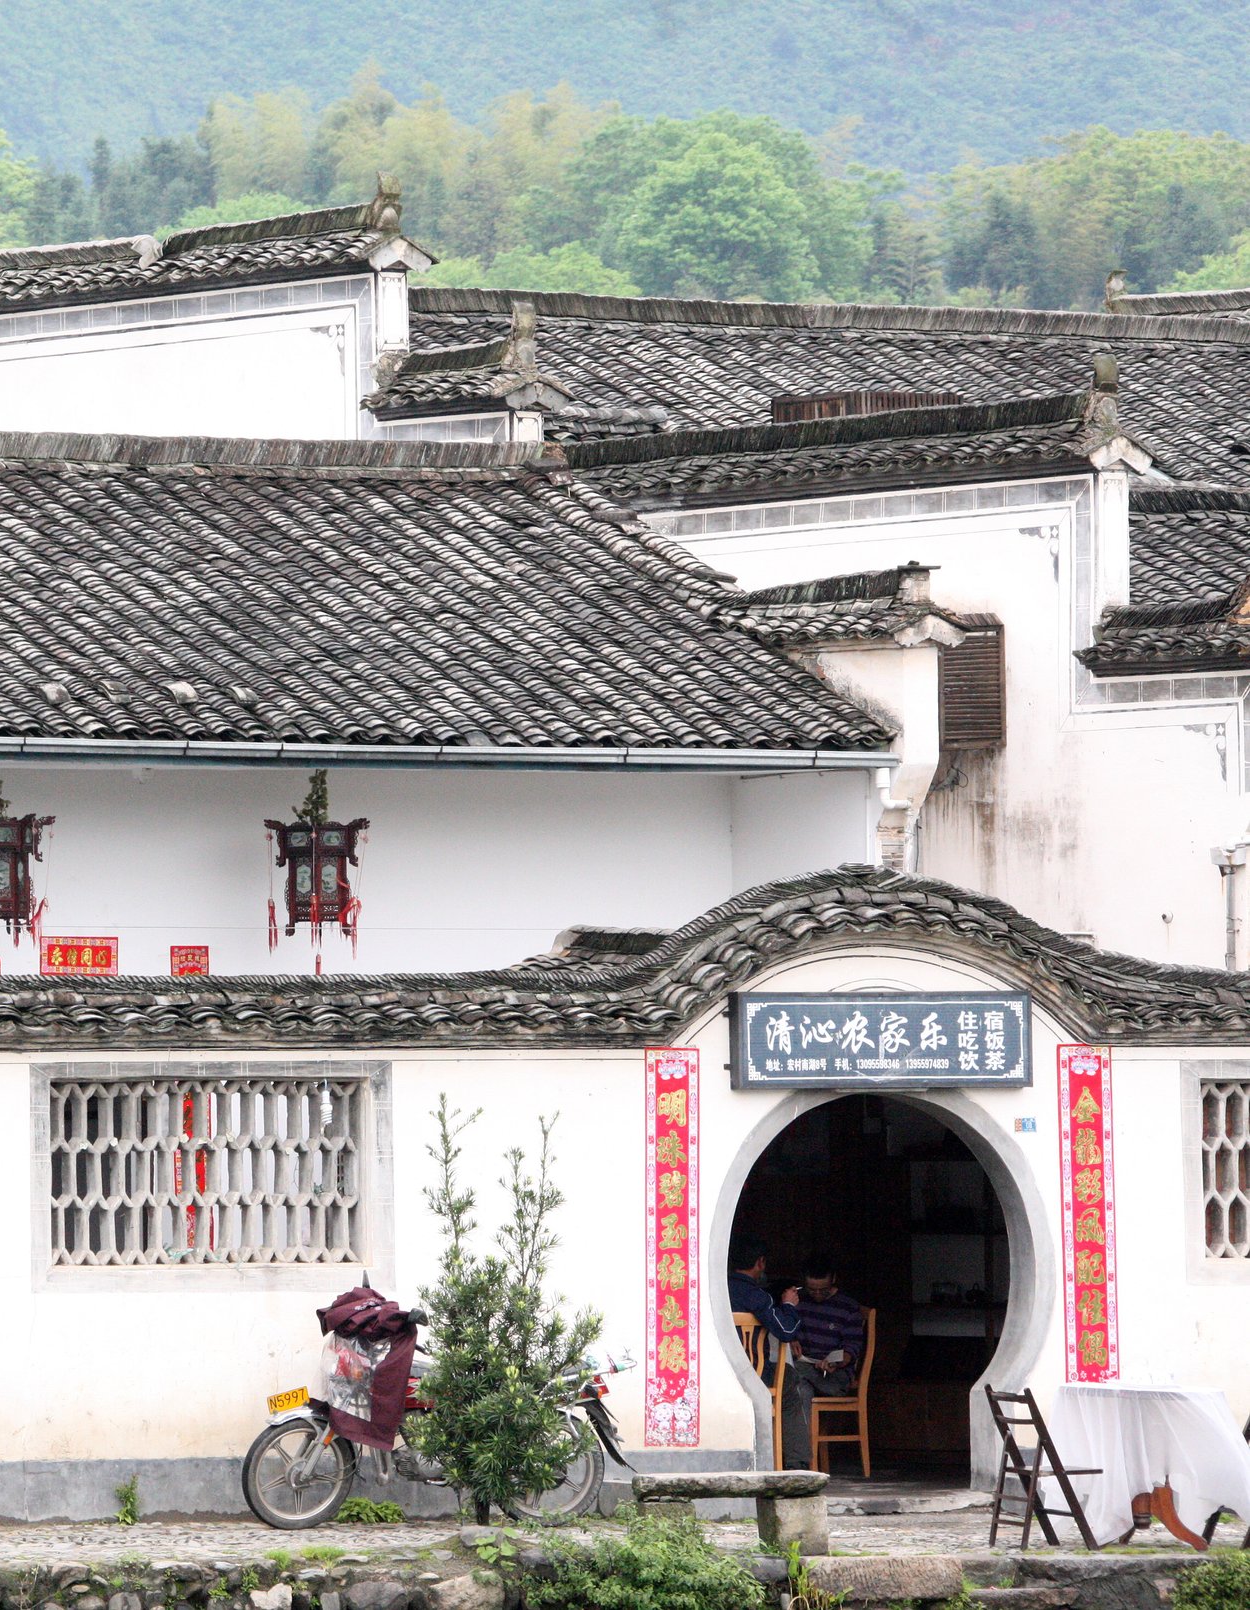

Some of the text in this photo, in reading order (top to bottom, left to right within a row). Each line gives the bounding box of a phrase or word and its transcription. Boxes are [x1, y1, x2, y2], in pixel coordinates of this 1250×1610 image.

[957, 1010, 1004, 1030] 住宿
[766, 1010, 948, 1054] 清沁农家乐
[958, 1031, 1005, 1050] 吃饭
[958, 1051, 1006, 1070] 饮茶
[269, 1388, 305, 1410] N5997
